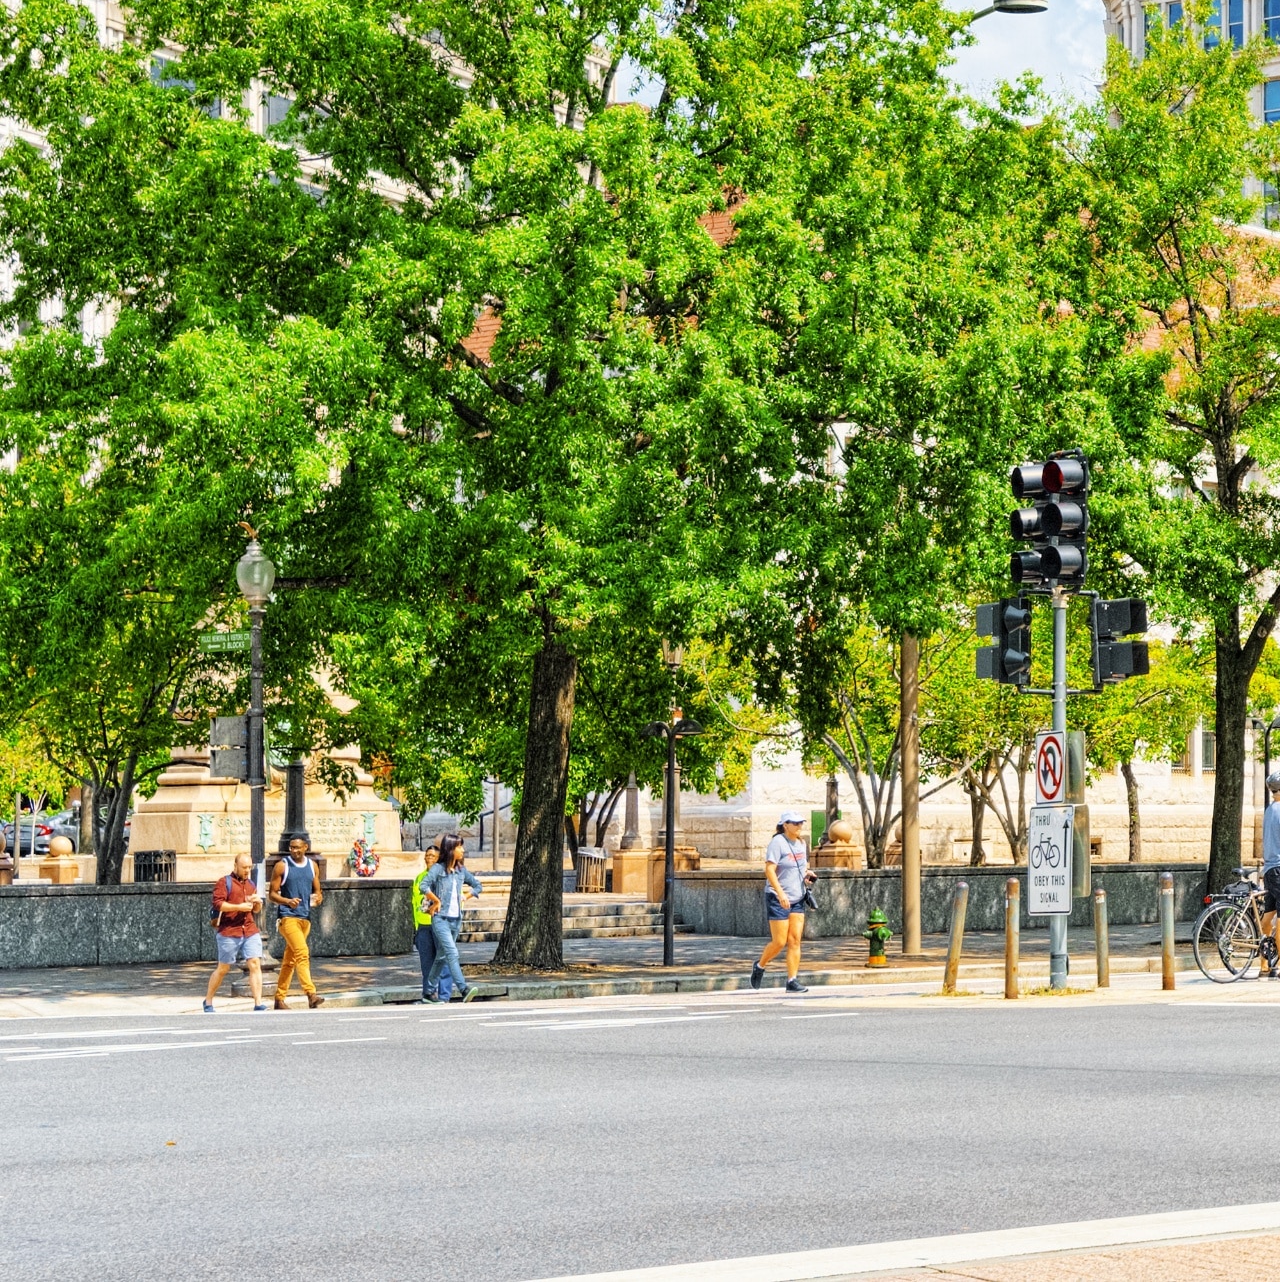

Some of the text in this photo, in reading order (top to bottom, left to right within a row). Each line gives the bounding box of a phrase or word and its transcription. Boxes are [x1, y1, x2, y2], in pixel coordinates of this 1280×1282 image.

[316, 818, 358, 827] REPUBLIC
[1035, 814, 1051, 826] THRU
[1034, 875, 1065, 886] OBEY THIS
[1040, 892, 1059, 903] SIGNAL
